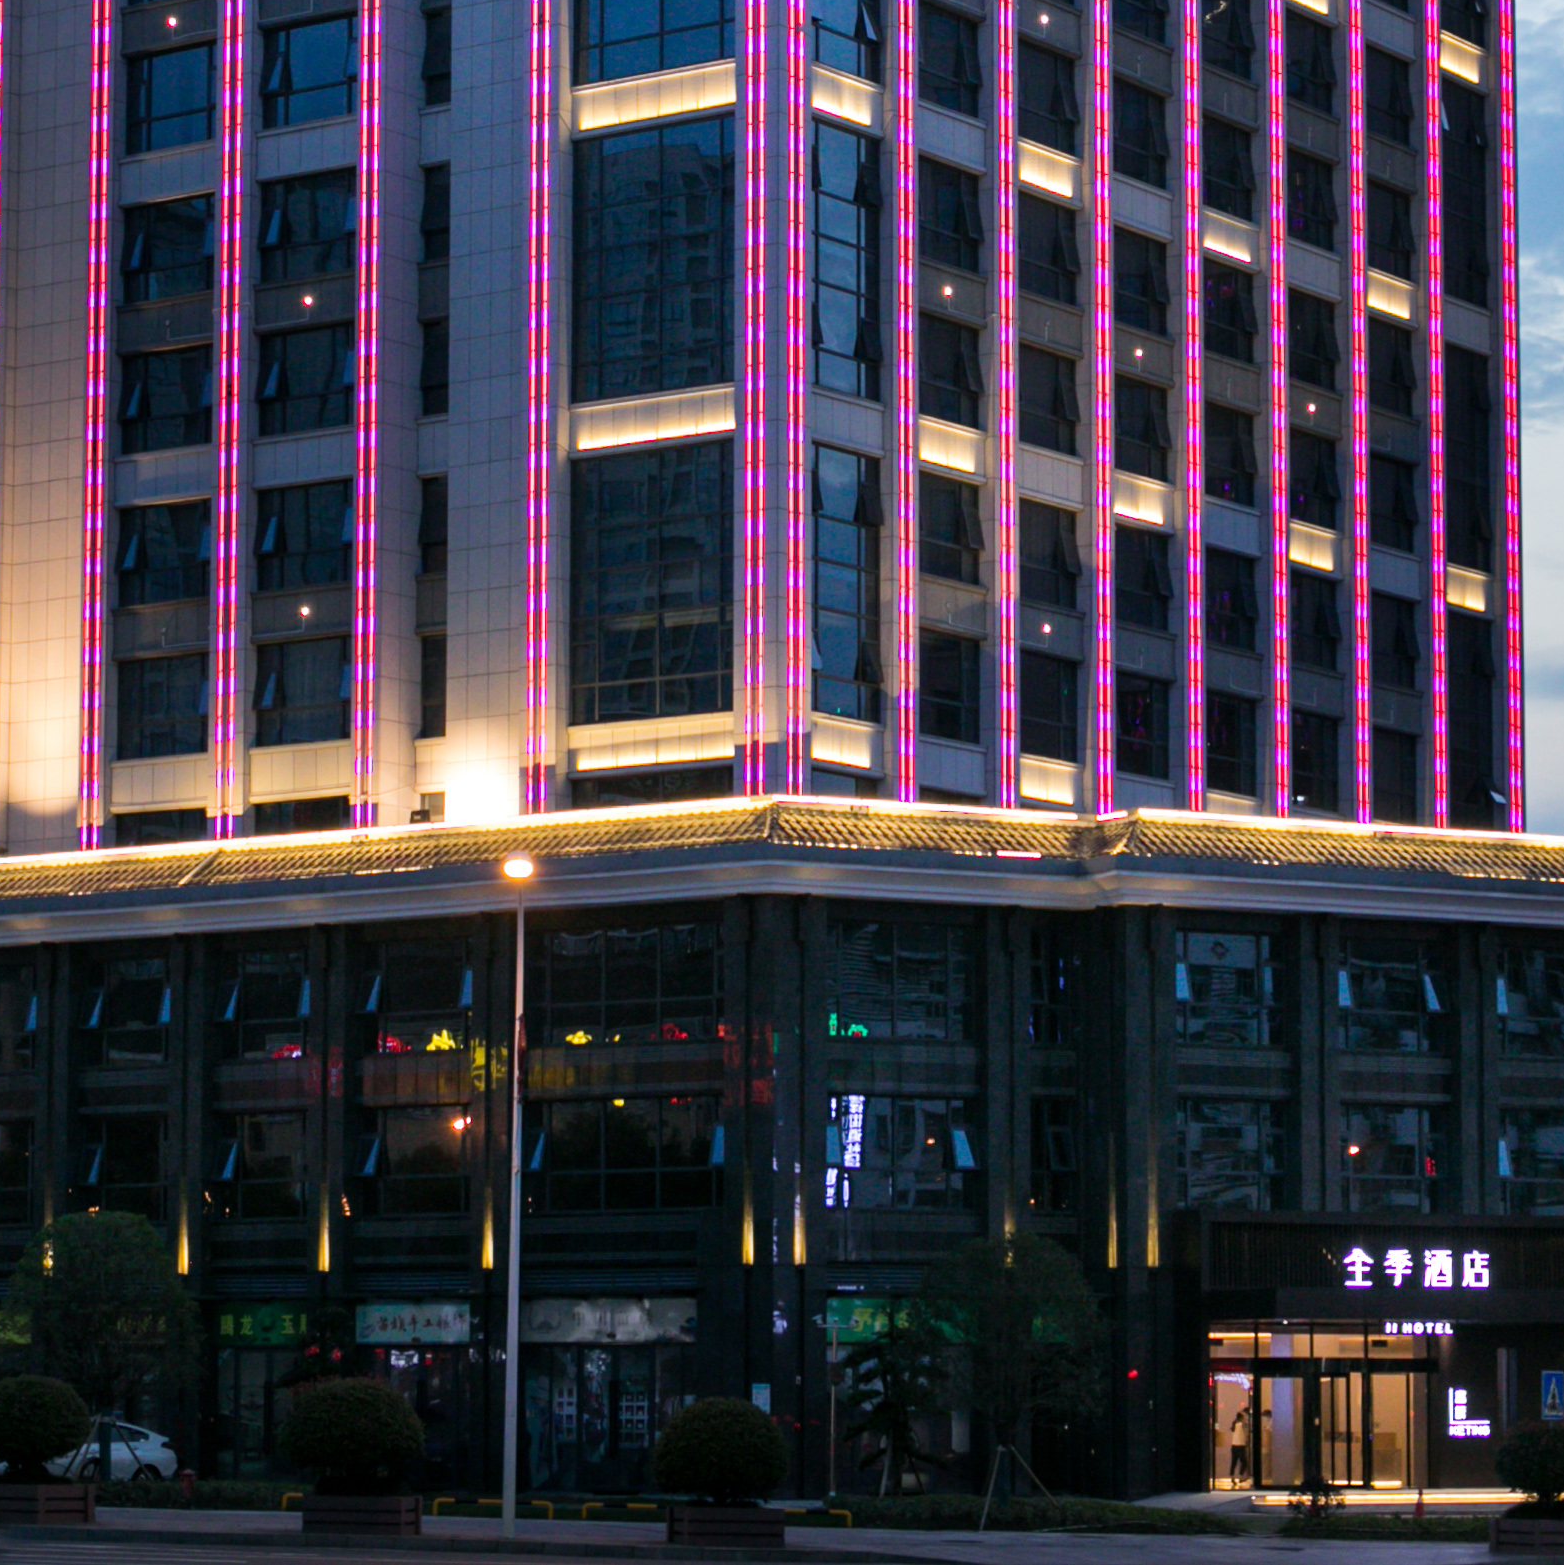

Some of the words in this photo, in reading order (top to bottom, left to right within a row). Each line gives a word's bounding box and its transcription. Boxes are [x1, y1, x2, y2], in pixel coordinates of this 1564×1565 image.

[1343, 1247, 1489, 1288] 全季酒店
[1401, 1321, 1454, 1336] HOTEL
